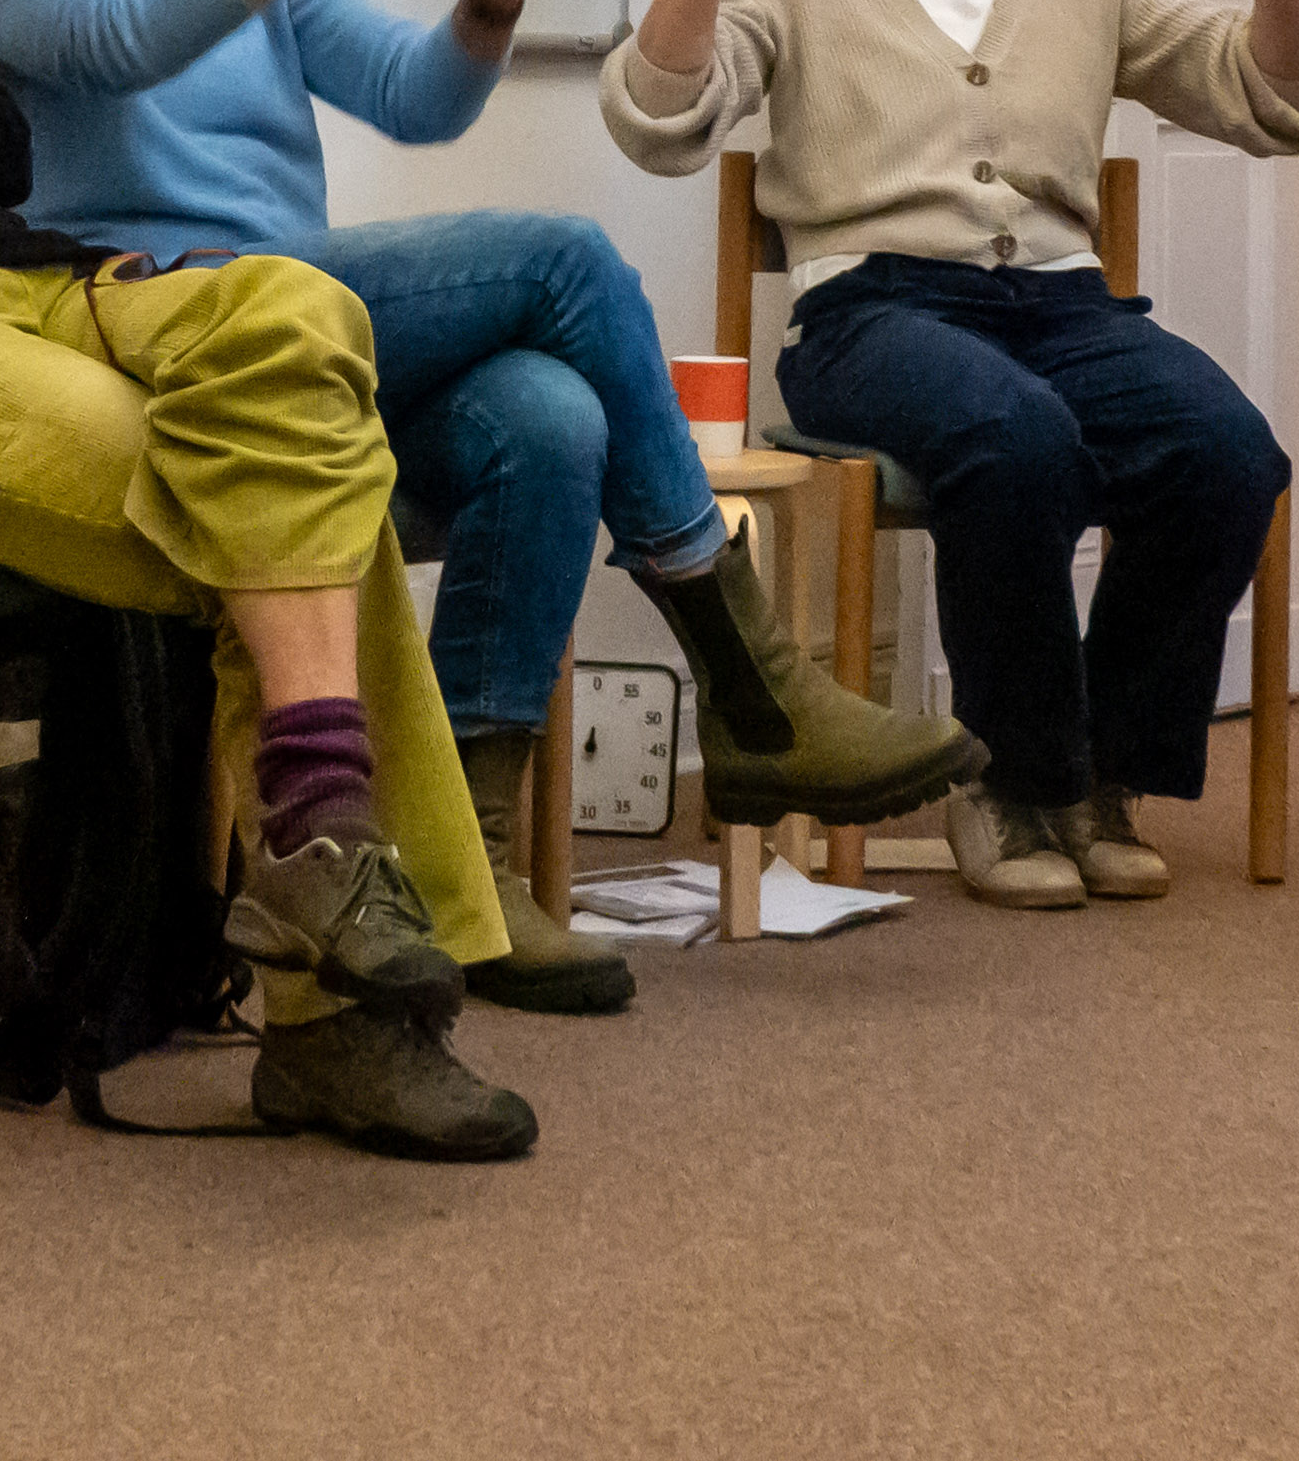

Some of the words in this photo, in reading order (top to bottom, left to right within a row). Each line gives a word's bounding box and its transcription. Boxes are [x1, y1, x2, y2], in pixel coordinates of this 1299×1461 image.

[645, 711, 662, 725] 50
[649, 743, 667, 757] 45
[640, 775, 658, 789] 40
[579, 805, 597, 819] 30
[614, 800, 631, 814] 35
